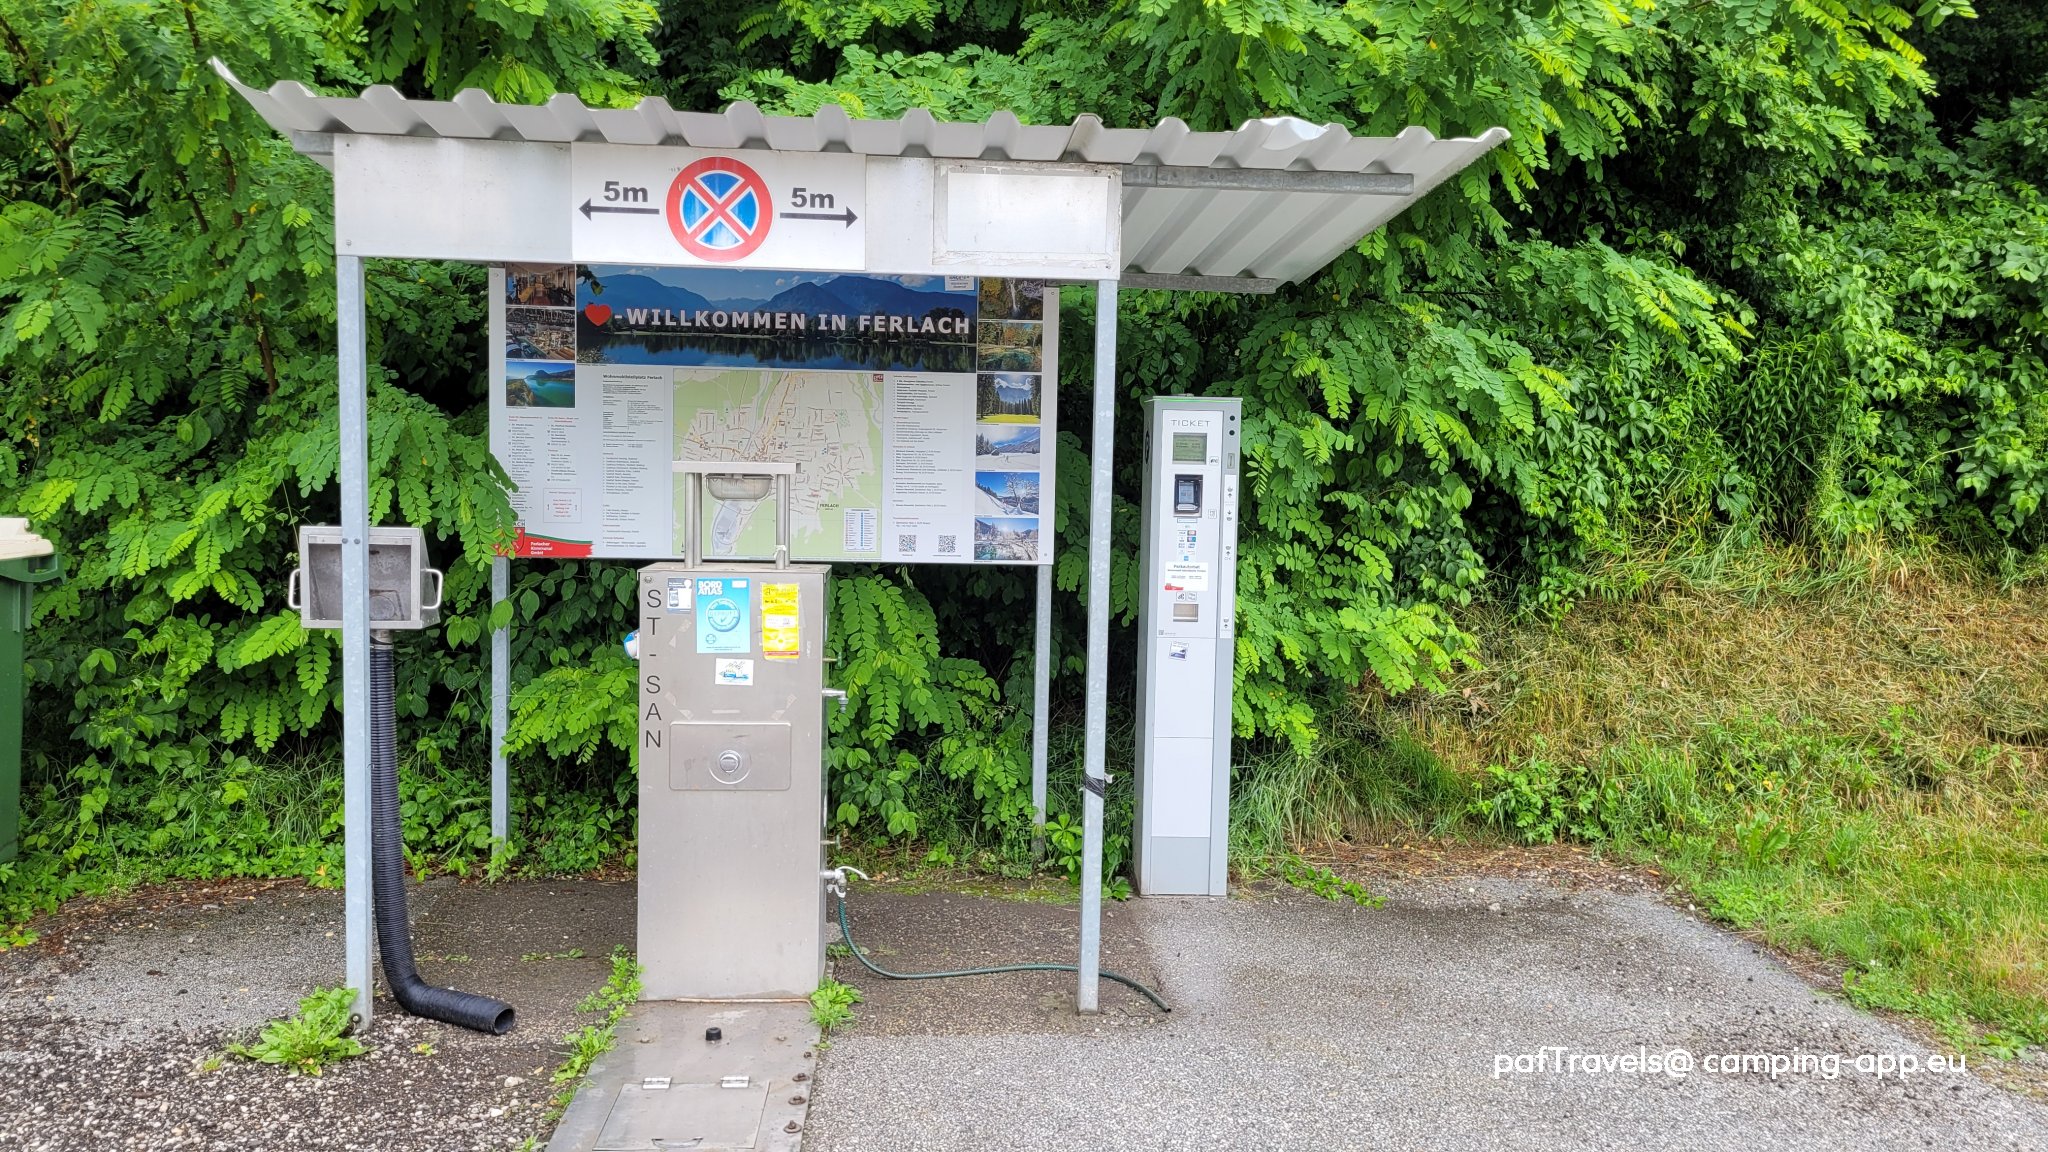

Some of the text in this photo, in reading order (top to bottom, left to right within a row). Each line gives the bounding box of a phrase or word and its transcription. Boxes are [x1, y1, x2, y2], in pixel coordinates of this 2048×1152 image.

[603, 180, 649, 203] 5m
[791, 187, 835, 209] 5m
[818, 314, 846, 331] IN
[859, 315, 969, 334] FERLACH
[697, 580, 723, 589] BORD
[697, 588, 723, 596] ATLAS
